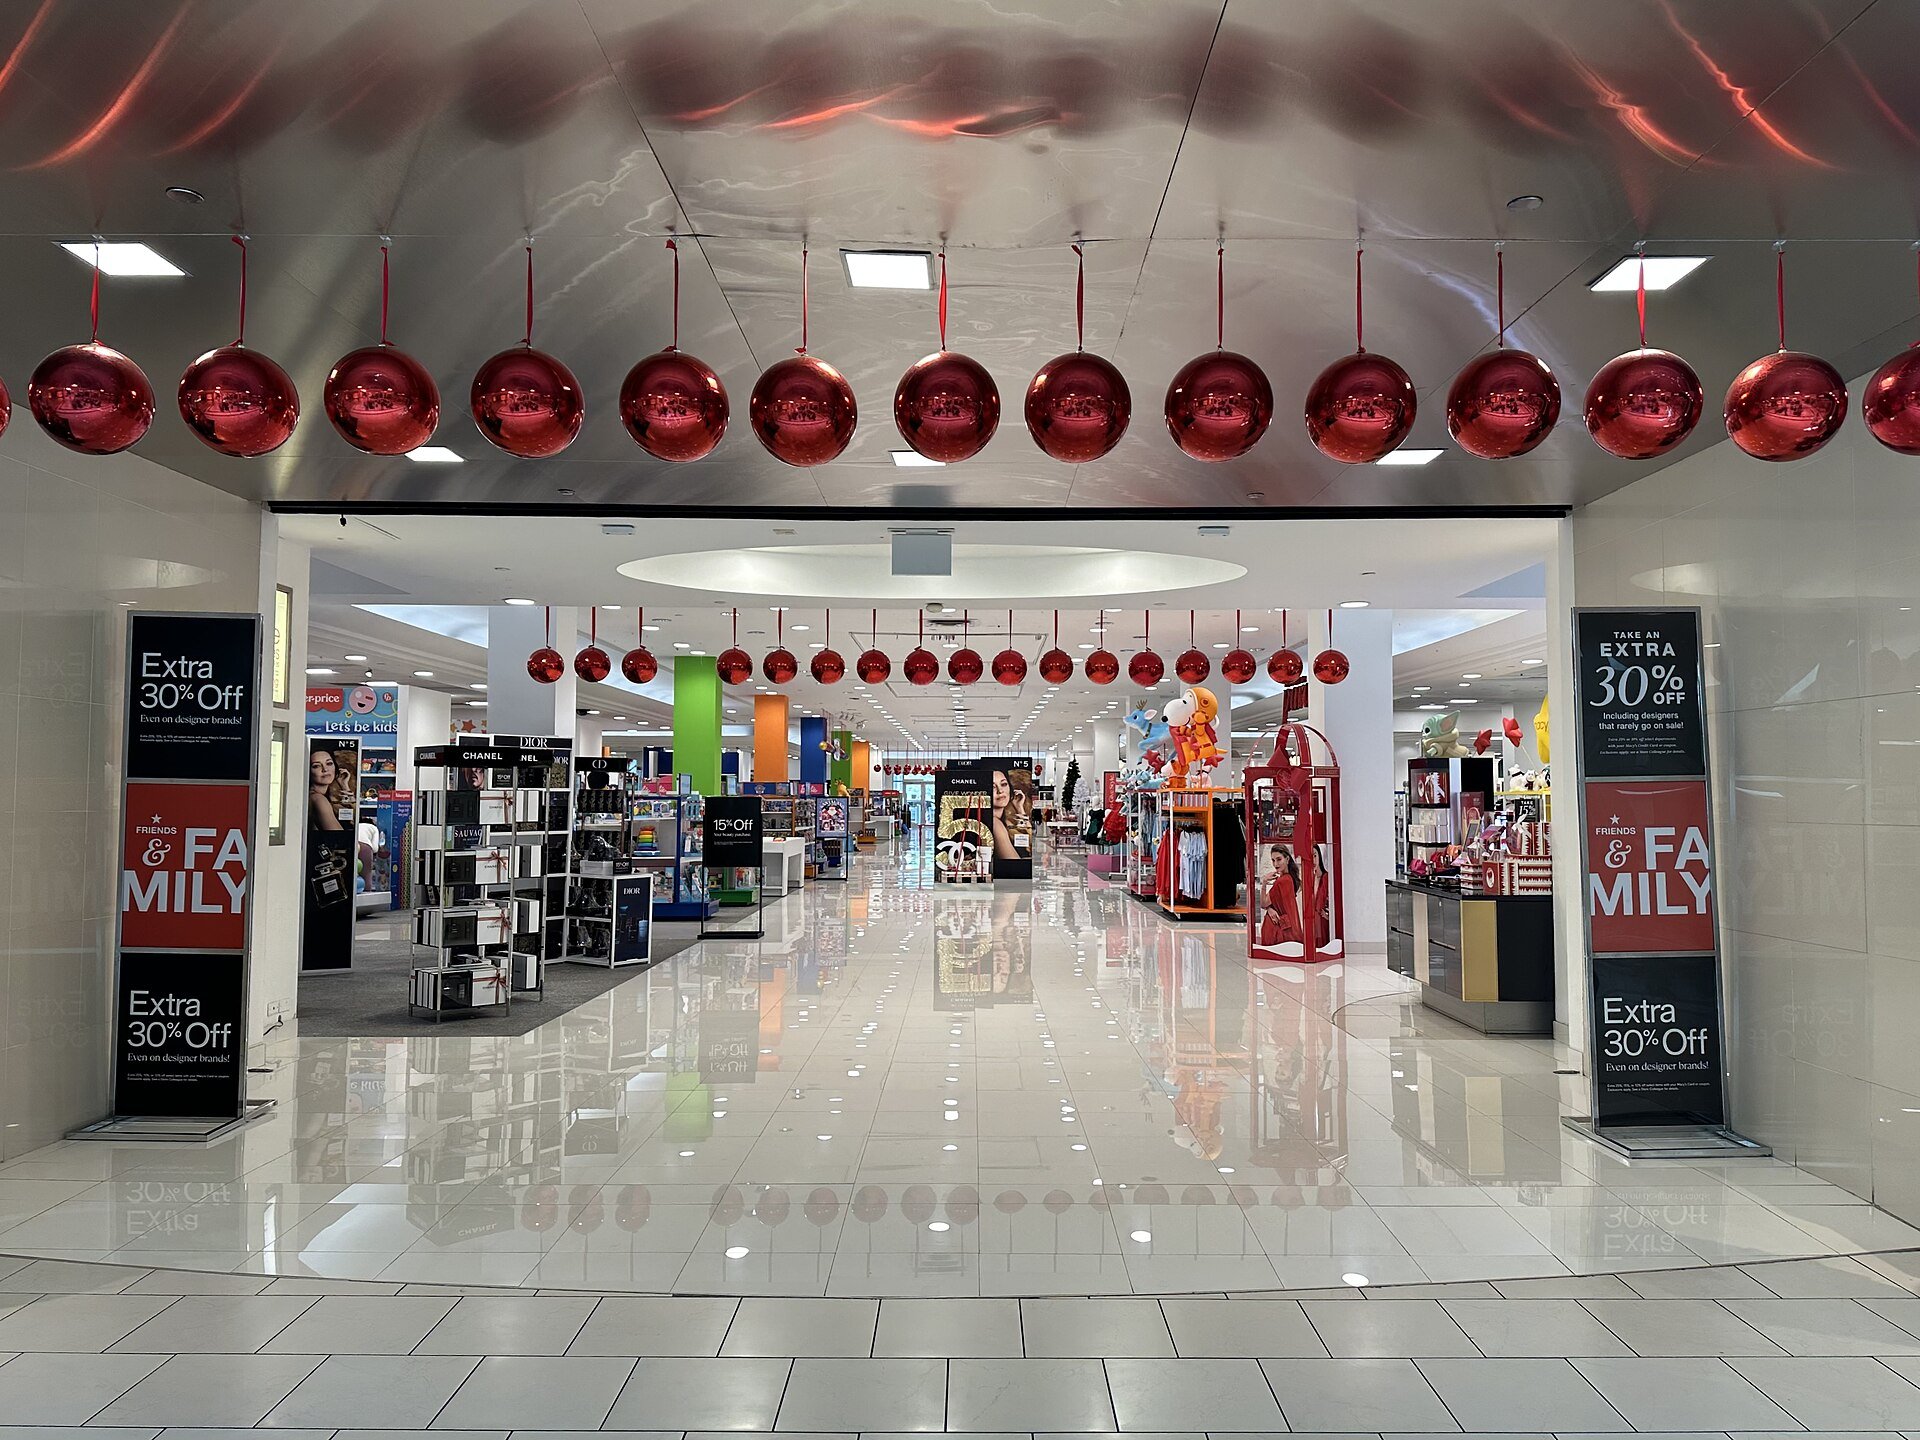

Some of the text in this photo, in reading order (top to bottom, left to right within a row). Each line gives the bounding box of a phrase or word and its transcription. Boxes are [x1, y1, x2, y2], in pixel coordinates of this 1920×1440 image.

[1613, 631, 1660, 639] TAKE AN
[1600, 642, 1676, 657] EXTRA
[142, 652, 213, 679] Extra
[139, 683, 244, 710] 30% Off
[1590, 665, 1684, 707] 30%
[1652, 692, 1685, 705] OFF
[140, 714, 160, 723] Even
[174, 715, 210, 725] designer
[211, 716, 242, 725] brands!
[325, 720, 398, 733] Let's be kids
[1599, 722, 1614, 730] that
[1616, 722, 1639, 731] rarely
[1641, 723, 1652, 731] go
[1603, 712, 1679, 721] Including designers
[520, 736, 548, 748] DIOR
[462, 752, 503, 760] CHANEL
[713, 819, 754, 831] 15% Off
[136, 826, 247, 870] FRIENDS FA
[142, 838, 171, 866] &
[1596, 827, 1710, 870] FRIENDS FA
[1604, 839, 1632, 868] &
[122, 870, 247, 914] MILY
[623, 887, 641, 895] DIOR
[1589, 871, 1711, 916] MILY
[129, 990, 201, 1017] Extra
[1603, 997, 1676, 1024] Extra
[127, 1021, 232, 1048] 30% Off
[1604, 1028, 1708, 1057] 30% Off
[127, 1053, 148, 1062] Even
[162, 1053, 197, 1064] designer
[199, 1054, 230, 1063] brands!
[1606, 1063, 1626, 1072] Even
[1641, 1062, 1677, 1072] designer
[1678, 1060, 1709, 1070] brands!
